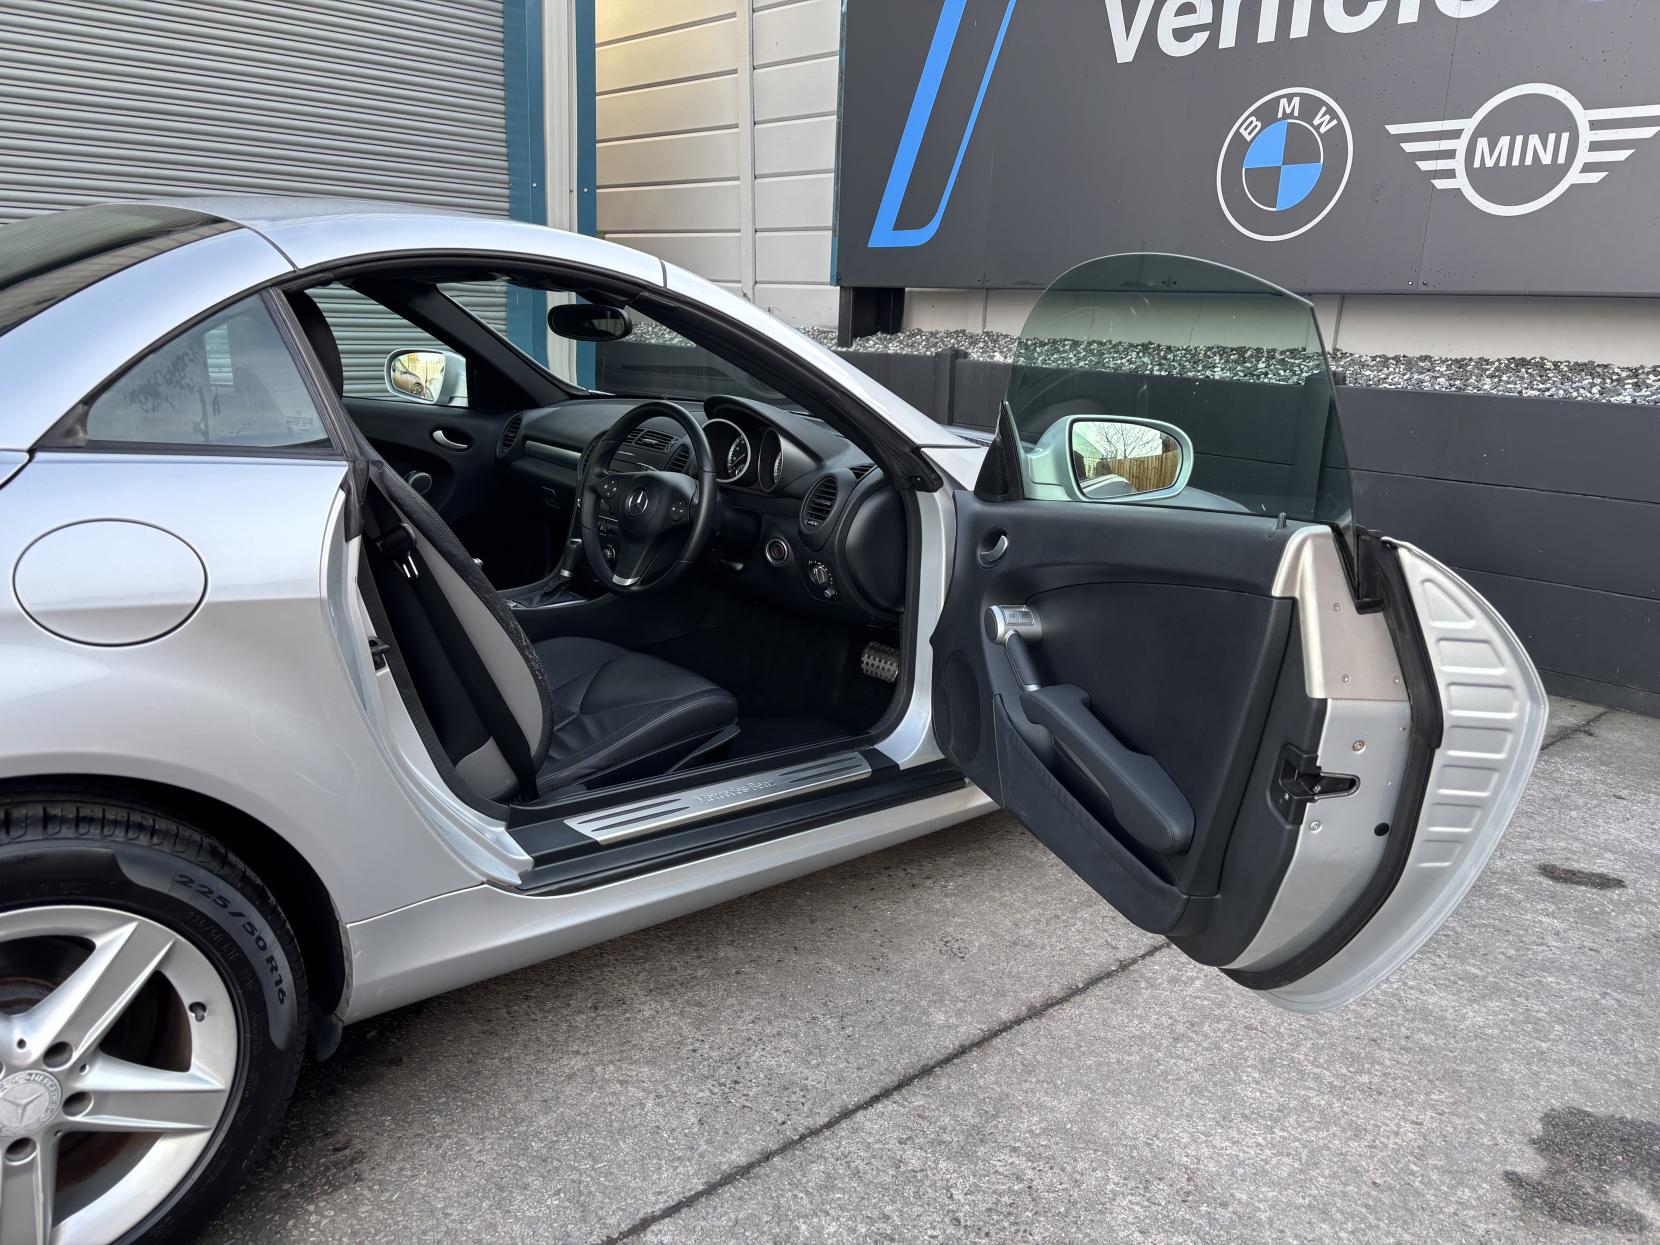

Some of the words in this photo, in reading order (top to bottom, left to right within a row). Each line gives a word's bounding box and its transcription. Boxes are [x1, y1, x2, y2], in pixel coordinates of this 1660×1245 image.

[1239, 96, 1338, 142] BMW
[1472, 132, 1571, 168] MINI
[176, 874, 268, 952] 225/50
[265, 954, 287, 1005] R16
